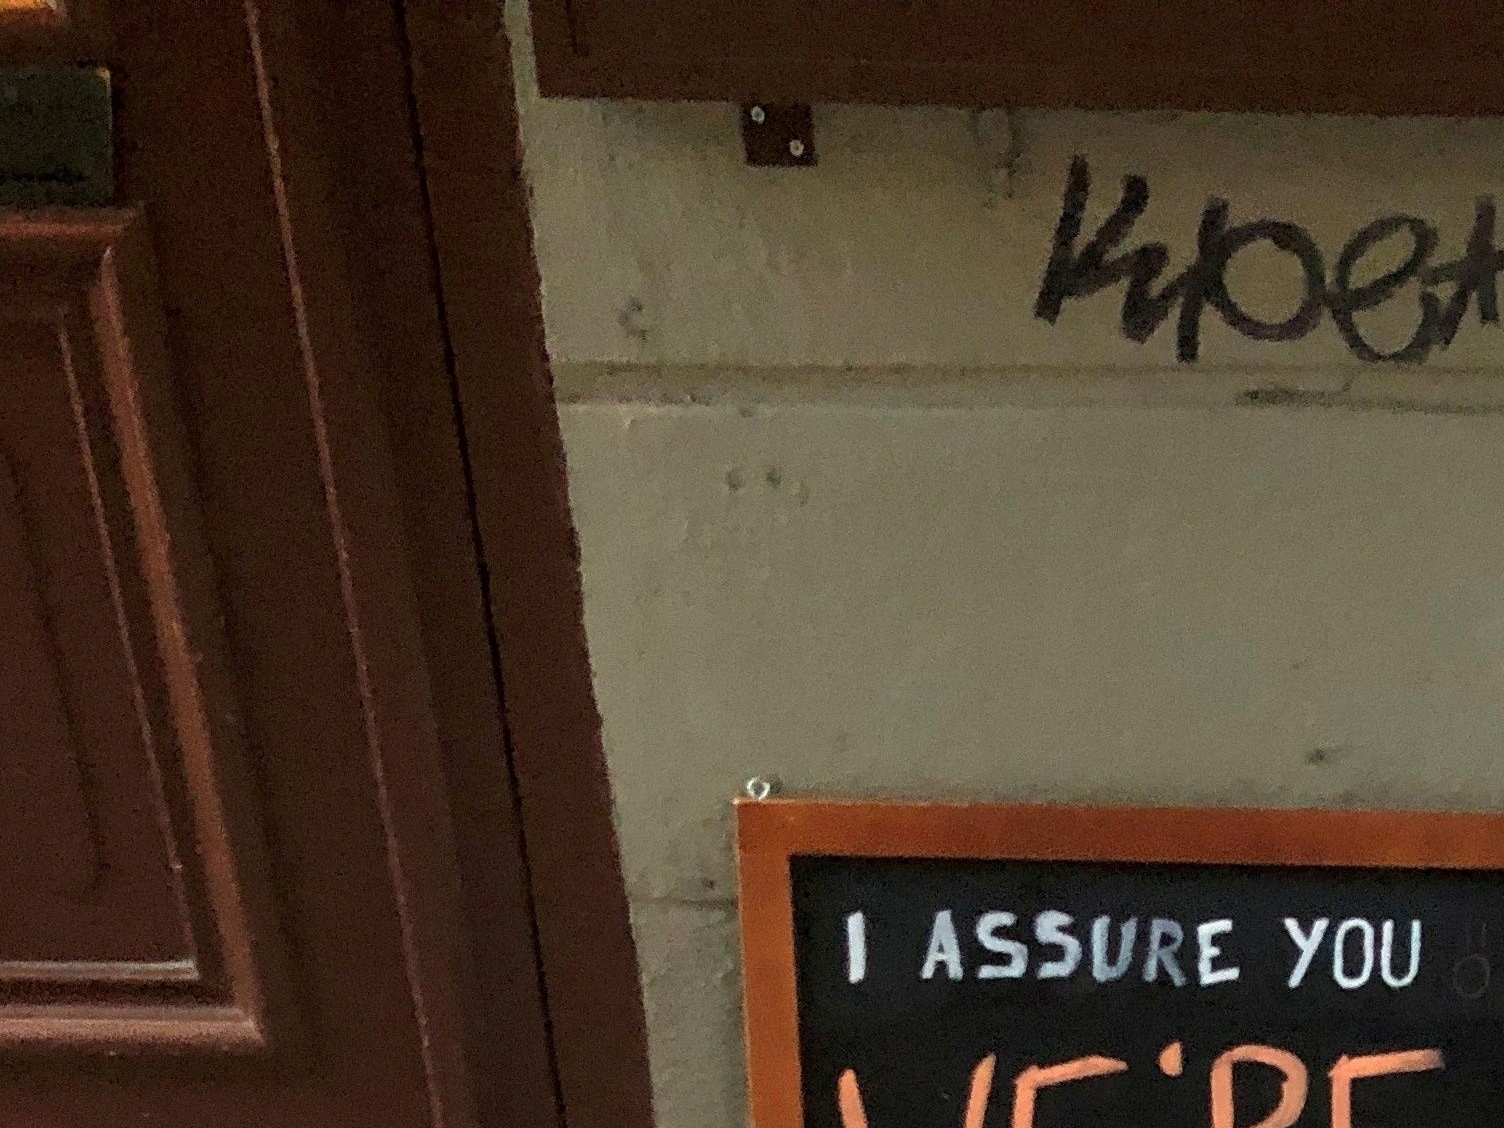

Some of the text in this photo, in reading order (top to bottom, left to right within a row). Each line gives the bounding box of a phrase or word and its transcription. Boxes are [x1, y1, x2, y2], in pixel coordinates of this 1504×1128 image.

[844, 908, 1423, 989] I ASSURE YOU
